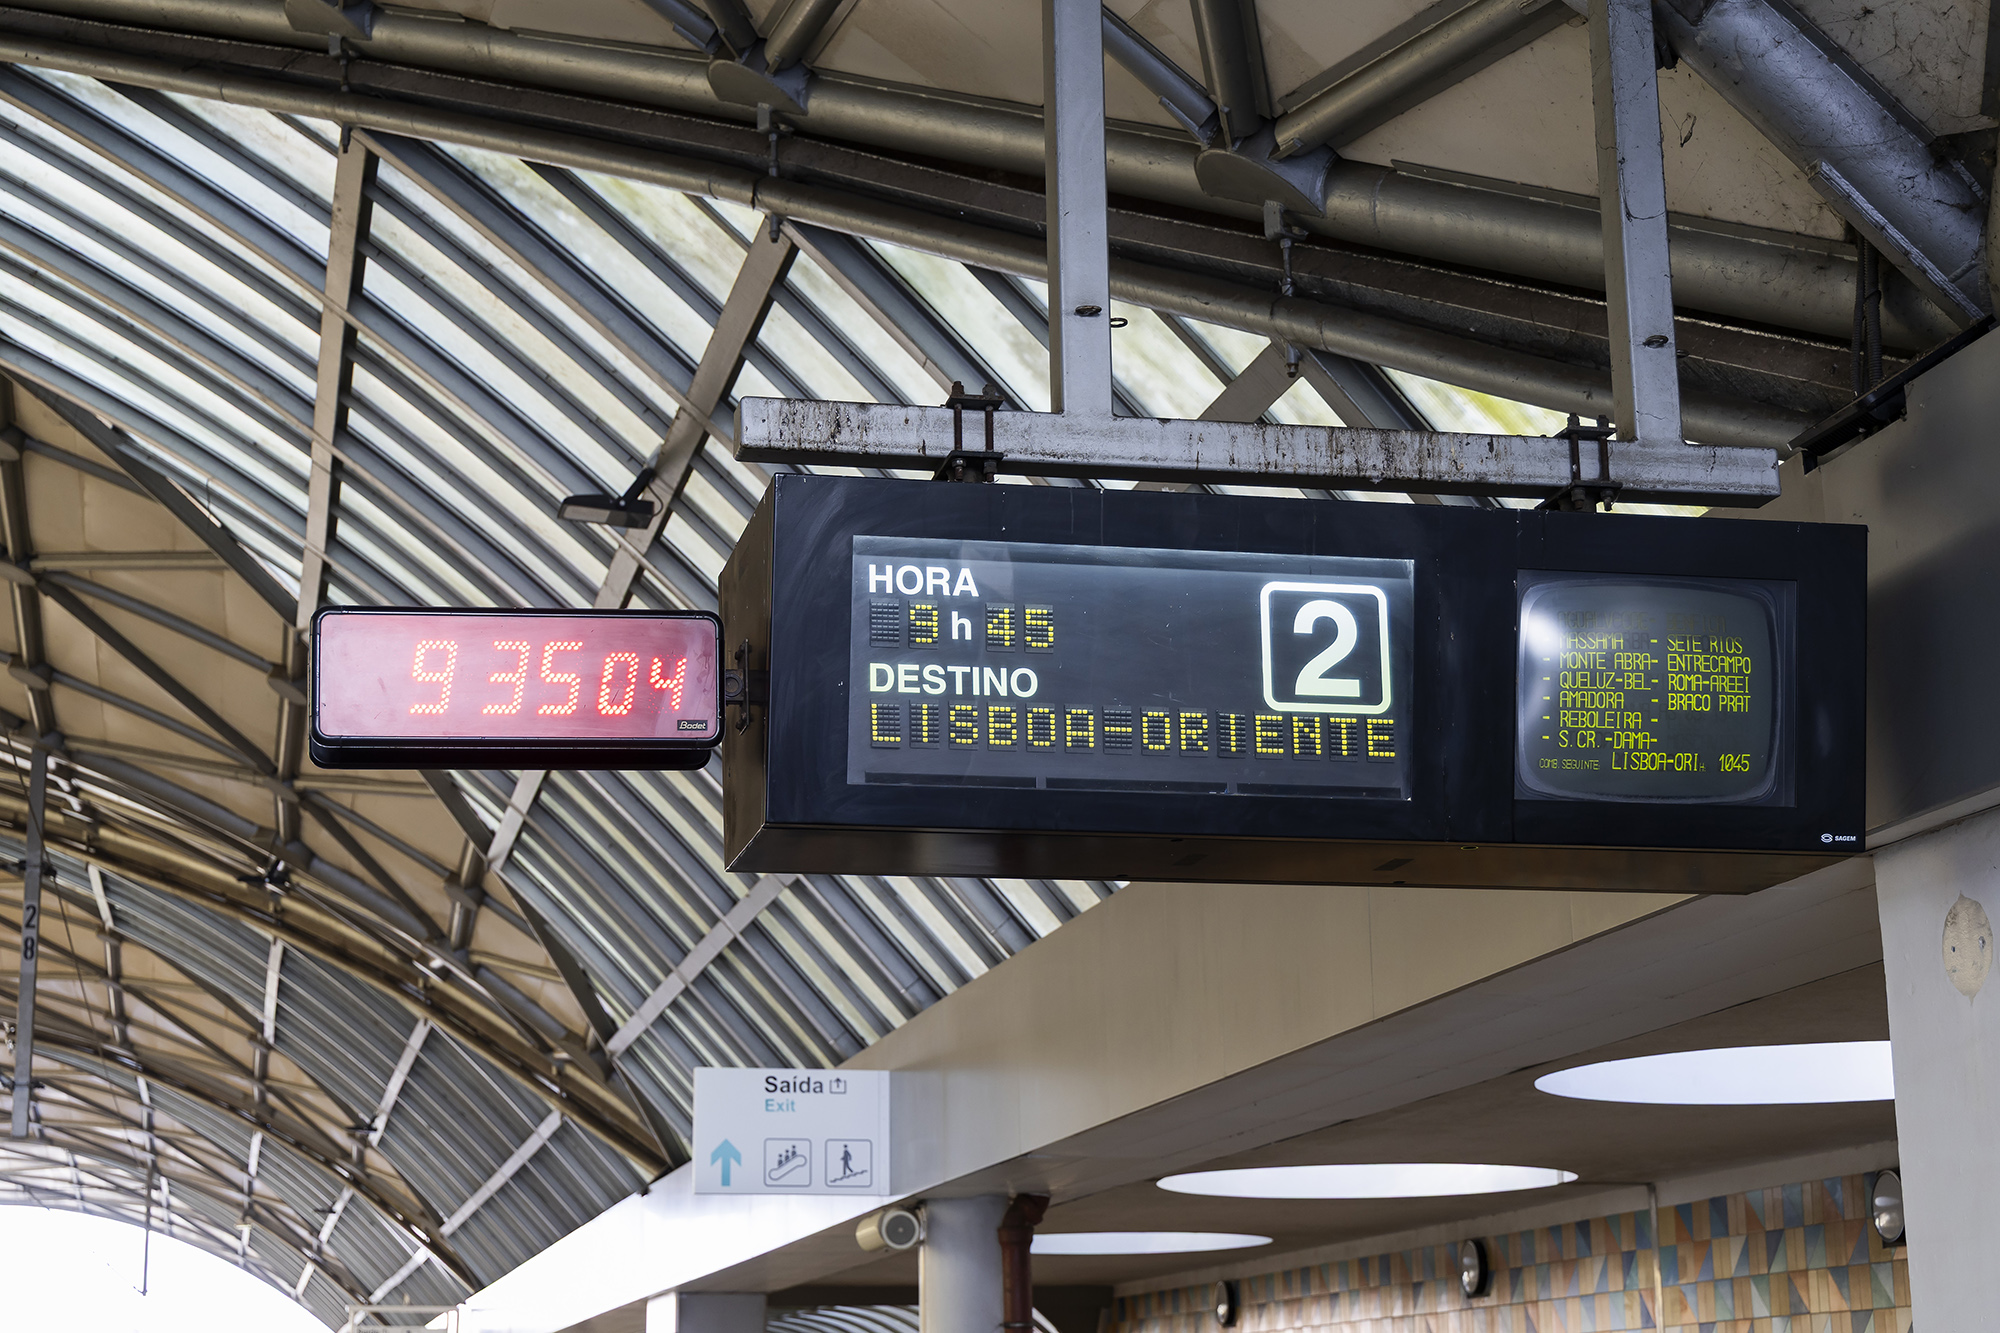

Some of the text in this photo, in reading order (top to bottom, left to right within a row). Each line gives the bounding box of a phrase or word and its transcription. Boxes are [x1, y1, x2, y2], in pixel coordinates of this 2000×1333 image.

[868, 564, 980, 598] HORA
[950, 610, 973, 641] h
[986, 607, 1055, 649] 45
[1292, 599, 1362, 699] 2
[1560, 631, 1624, 650] MASSAMA
[1666, 633, 1743, 654] SETE RIOS
[1559, 651, 1606, 669] MONTE
[1667, 653, 1751, 674] ENTRECAMPO
[868, 662, 1039, 698] DESTINO
[1667, 673, 1749, 693] ROMA-AREEI
[1559, 690, 1624, 709] AMADORA
[1667, 693, 1751, 712] BRACO PRAT
[678, 720, 707, 730] Bodet
[1559, 710, 1642, 729] REBOLEIRA
[871, 703, 1397, 758] LISBOA-ORIENTE
[1718, 753, 1751, 772] 1045
[764, 1075, 824, 1094] Saída
[764, 1098, 796, 1113] Exit
